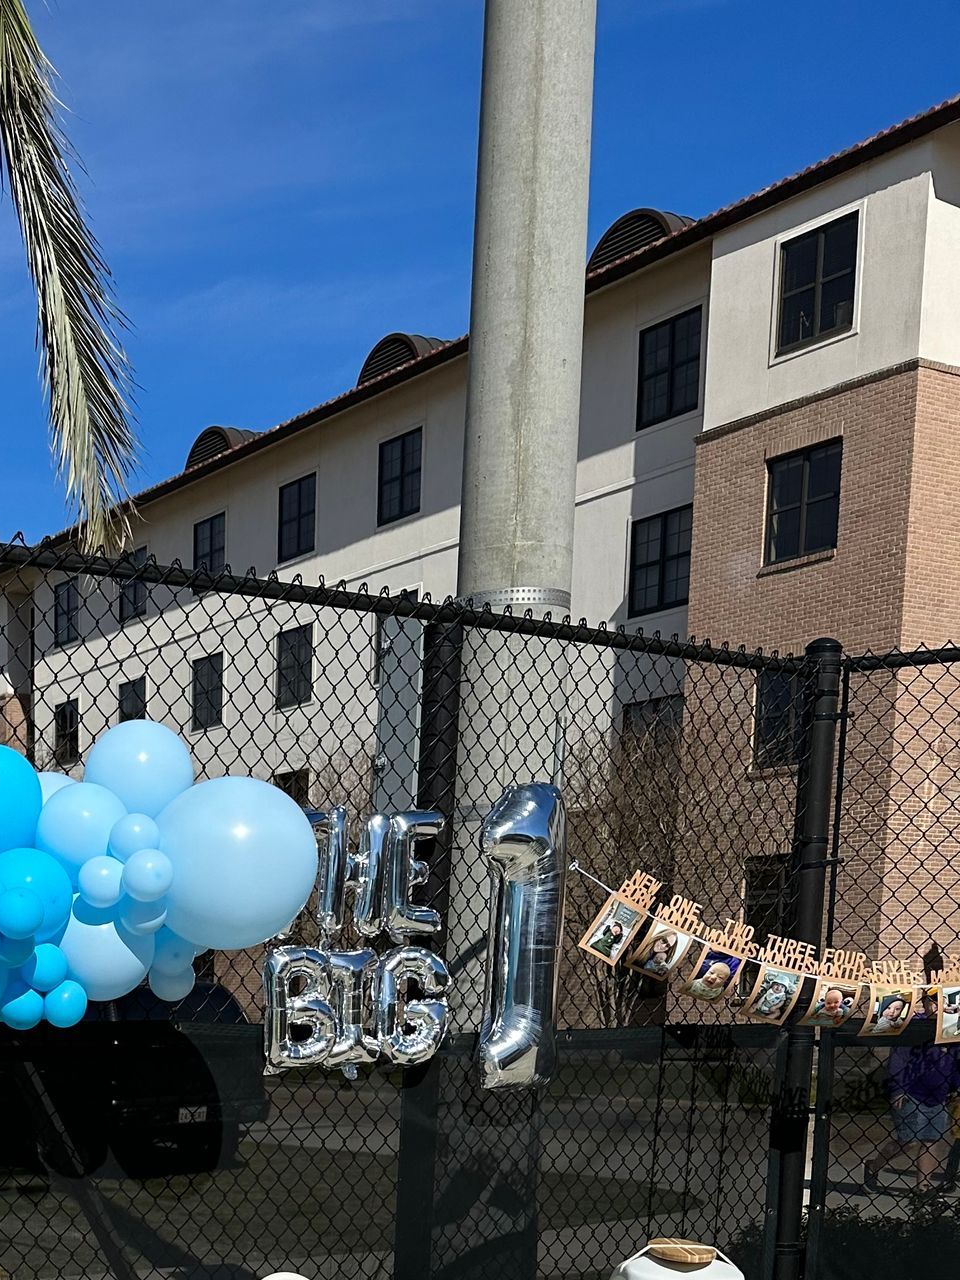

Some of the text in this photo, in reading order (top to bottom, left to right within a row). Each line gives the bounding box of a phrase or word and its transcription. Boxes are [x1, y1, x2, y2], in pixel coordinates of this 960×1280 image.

[304, 804, 445, 937] HE
[630, 869, 662, 895] NEW
[618, 879, 656, 909] BORN
[670, 895, 703, 918] ONE
[655, 902, 705, 936] MONTH
[725, 918, 755, 941] TWO
[702, 926, 760, 958] MONTHS
[766, 933, 816, 962] THREE
[757, 947, 815, 974] MONTHS
[823, 948, 867, 967] FOUR
[871, 960, 910, 973] FIVE
[813, 961, 873, 984] MONTHS
[869, 970, 924, 985] MONTHS
[263, 945, 452, 1070] BIG
